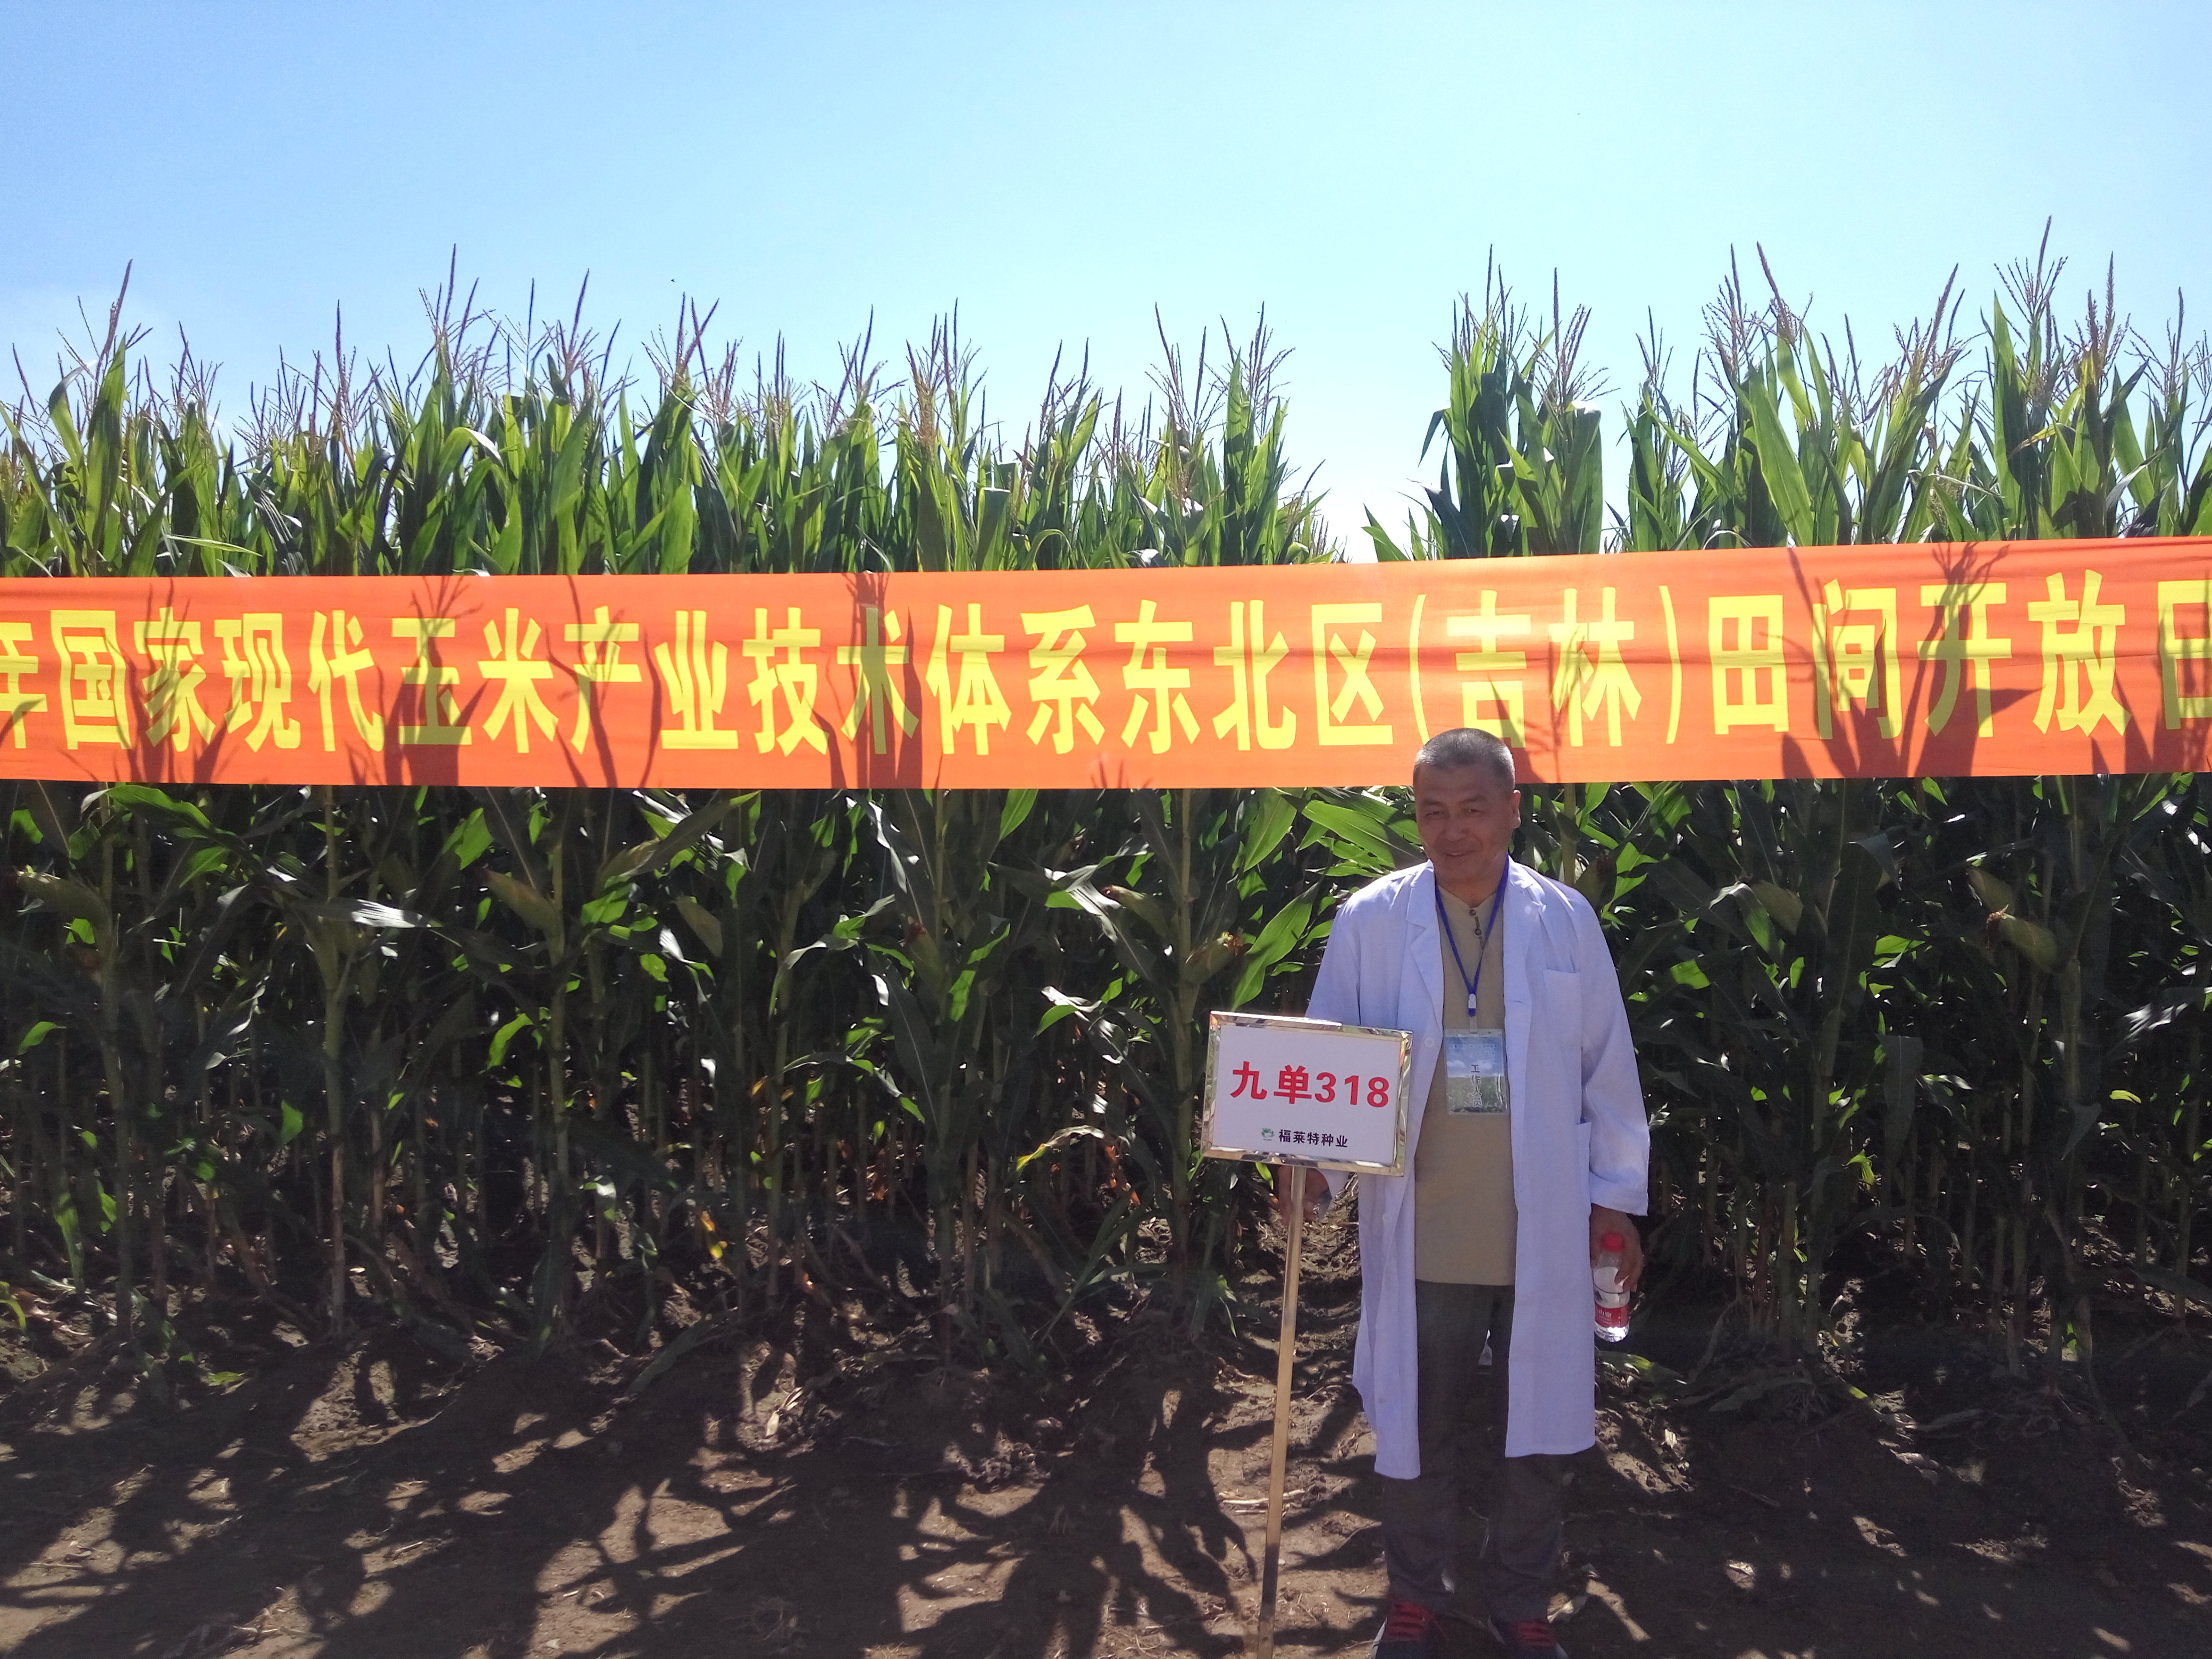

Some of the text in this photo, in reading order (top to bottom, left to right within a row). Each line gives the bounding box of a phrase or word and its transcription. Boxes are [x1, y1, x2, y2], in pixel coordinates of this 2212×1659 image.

[1230, 1061, 1390, 1108] 九单318
[1471, 1065, 1483, 1108] 工作人员
[1279, 1129, 1348, 1147] 福莱特种业
